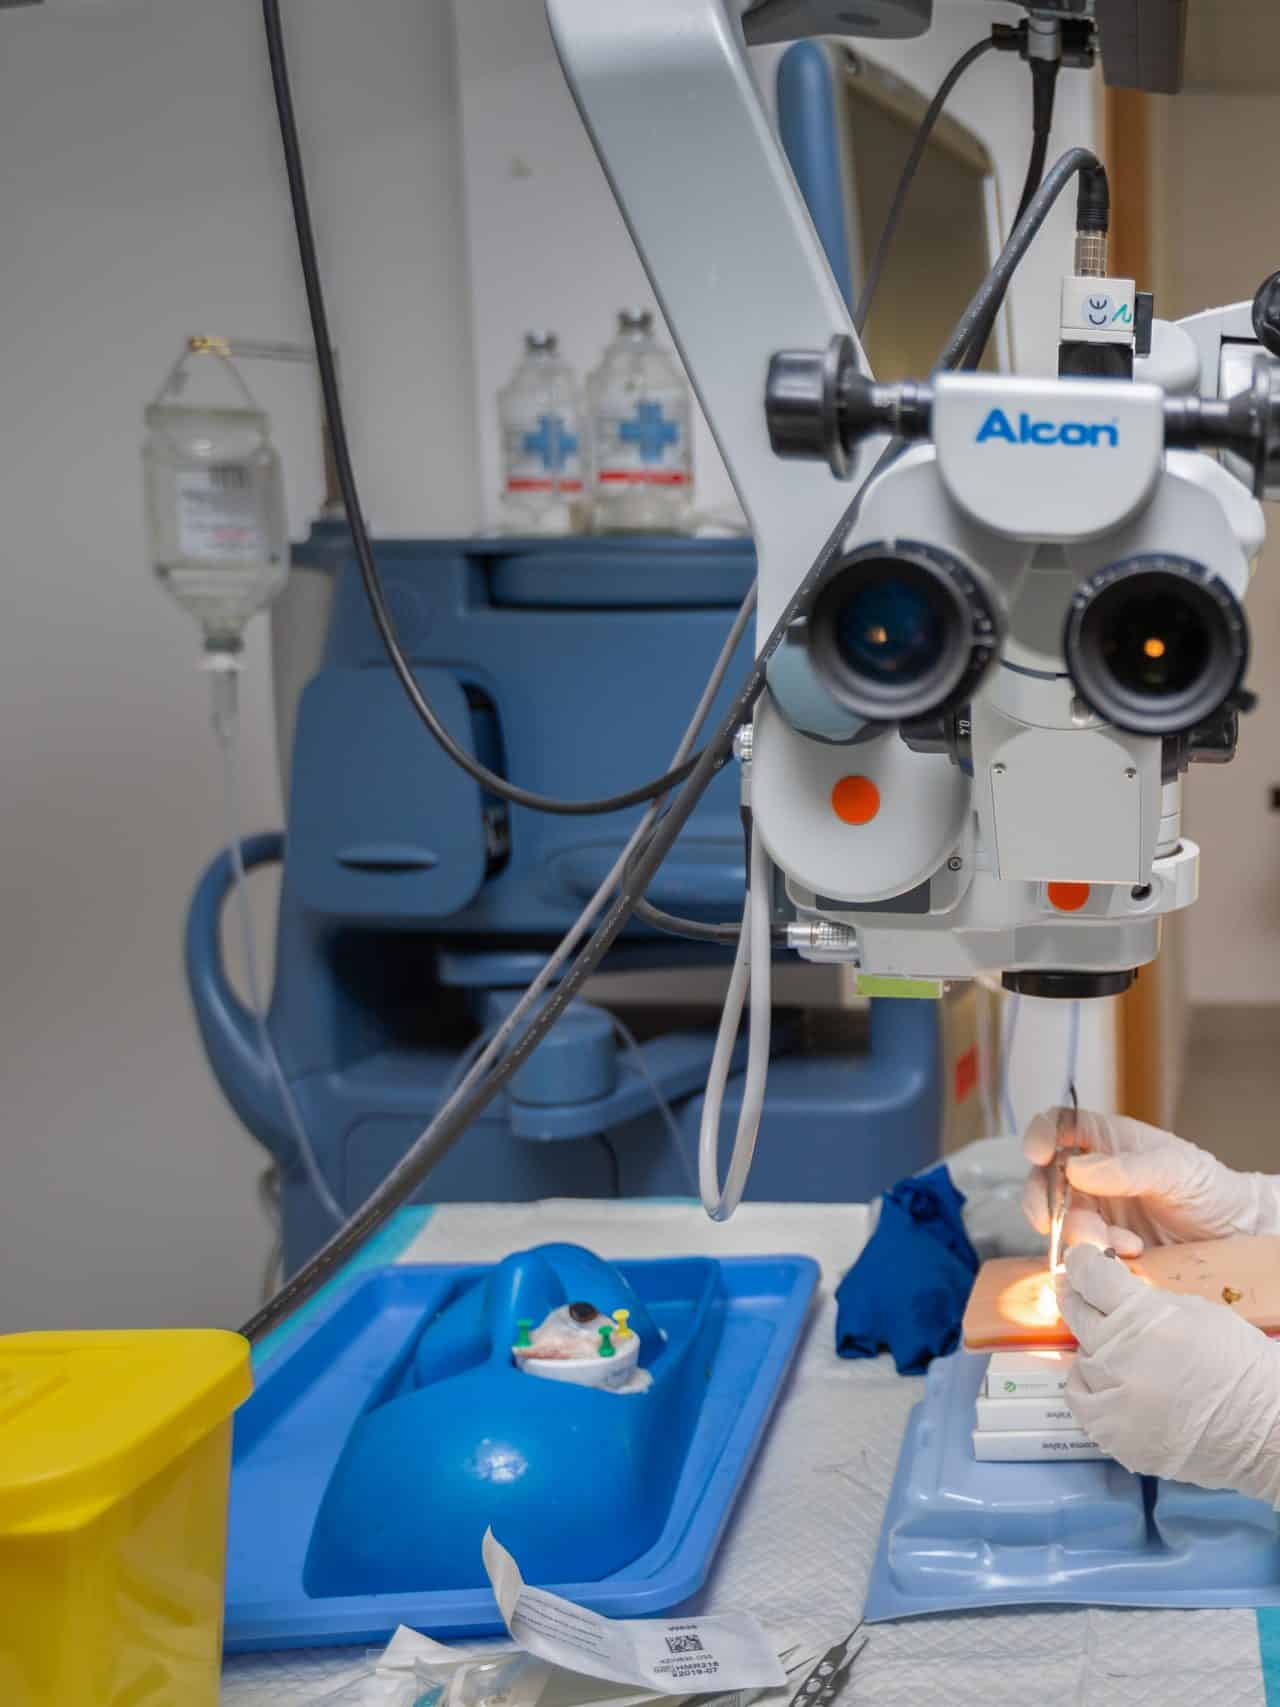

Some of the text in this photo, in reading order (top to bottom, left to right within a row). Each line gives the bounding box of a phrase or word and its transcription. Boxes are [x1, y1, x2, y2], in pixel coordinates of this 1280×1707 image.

[1088, 298, 1108, 325] CE
[975, 408, 1119, 448] Alcon
[1042, 1441, 1069, 1451] Valve
